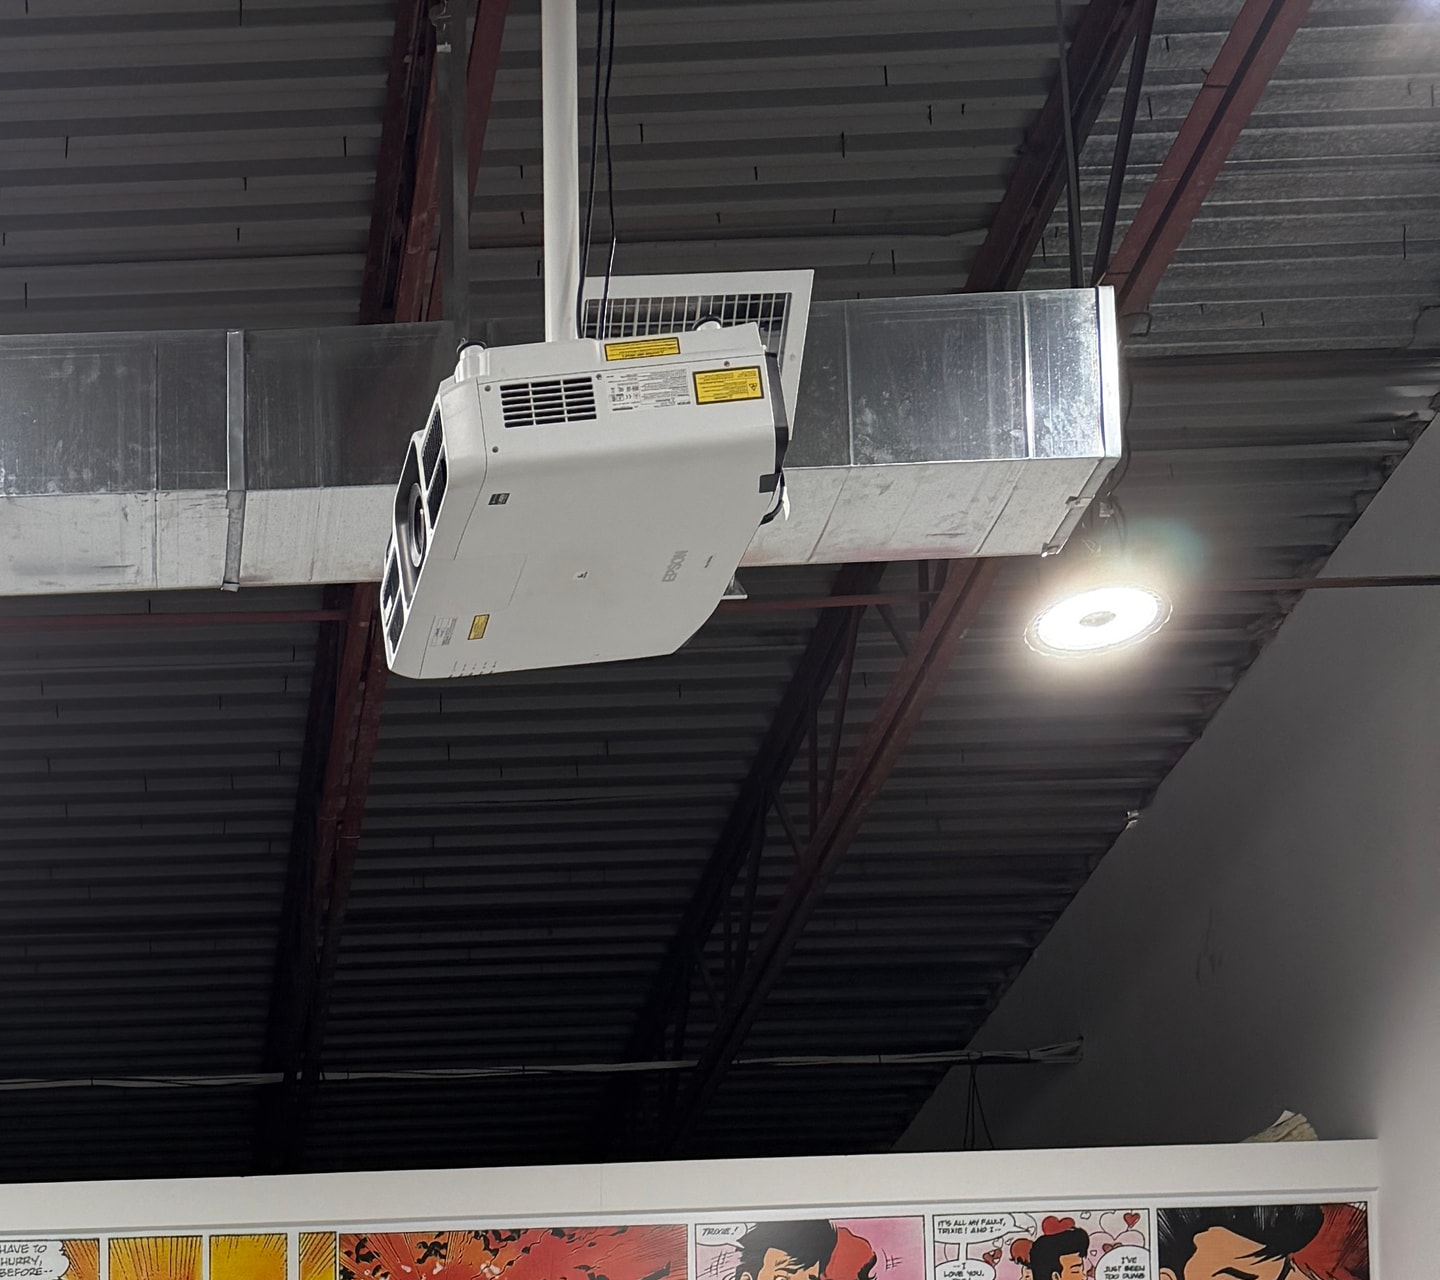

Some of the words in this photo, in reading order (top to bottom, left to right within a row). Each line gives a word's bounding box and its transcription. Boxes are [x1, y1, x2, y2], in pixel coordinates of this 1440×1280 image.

[661, 550, 689, 582] EPSON
[32, 1244, 48, 1254] TO
[0, 1256, 42, 1266] HURRY,
